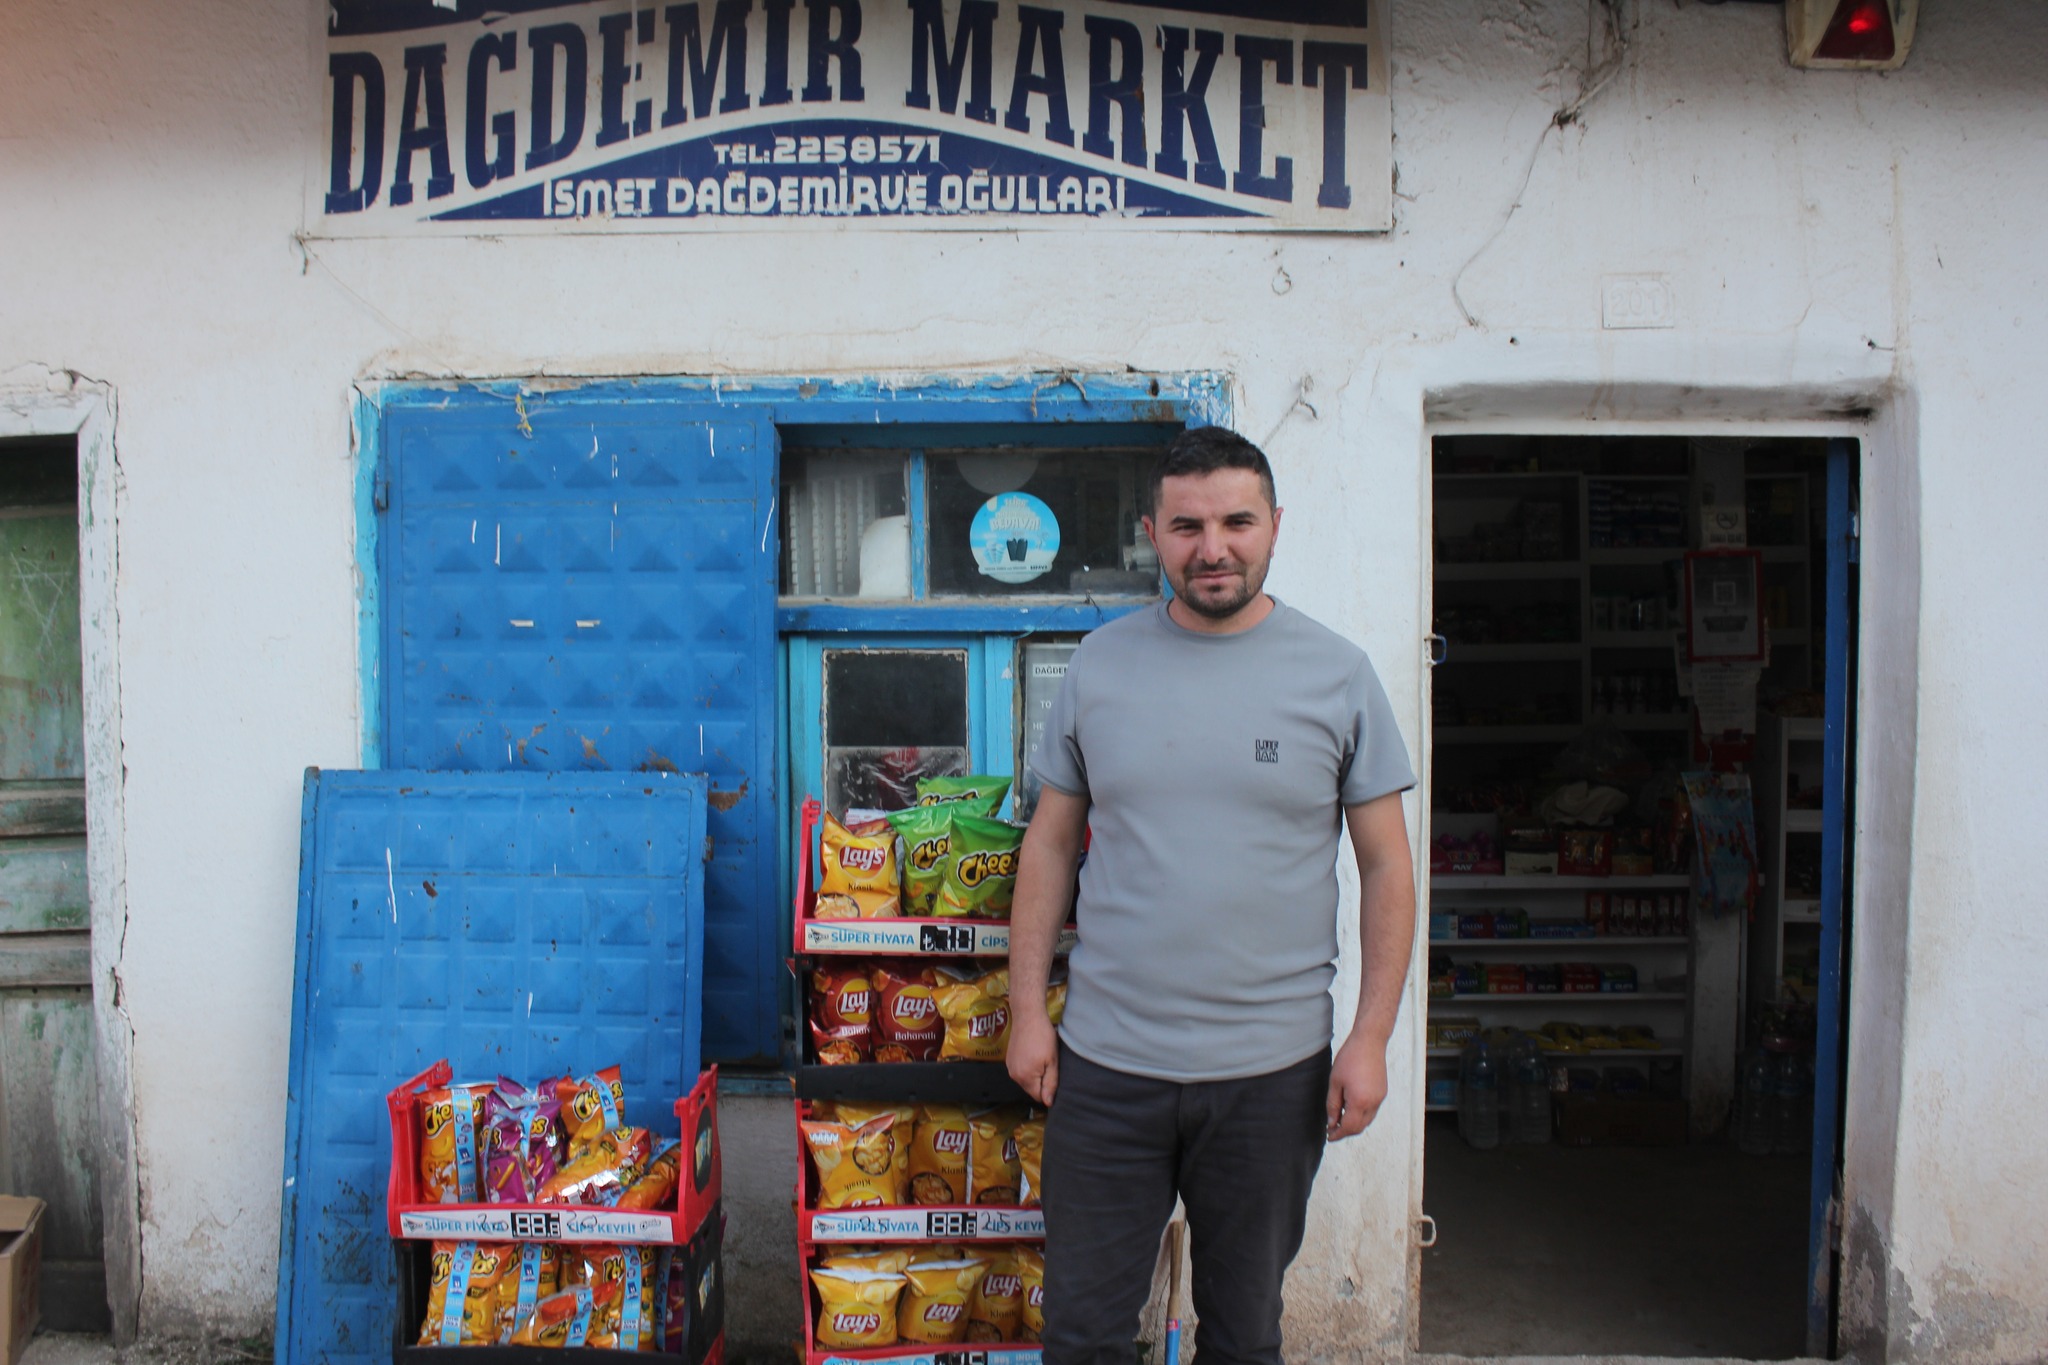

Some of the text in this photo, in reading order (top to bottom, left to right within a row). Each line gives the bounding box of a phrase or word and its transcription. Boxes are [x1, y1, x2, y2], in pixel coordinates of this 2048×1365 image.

[905, 0, 1368, 208] MARKET
[842, 846, 884, 870] Lay's
[831, 928, 870, 943] SÜPER
[874, 931, 915, 945] FİYATA
[982, 934, 1008, 948] CİPS
[895, 995, 936, 1017] Lay's
[970, 1008, 1005, 1038] Lay's
[835, 1312, 878, 1335] Lay's
